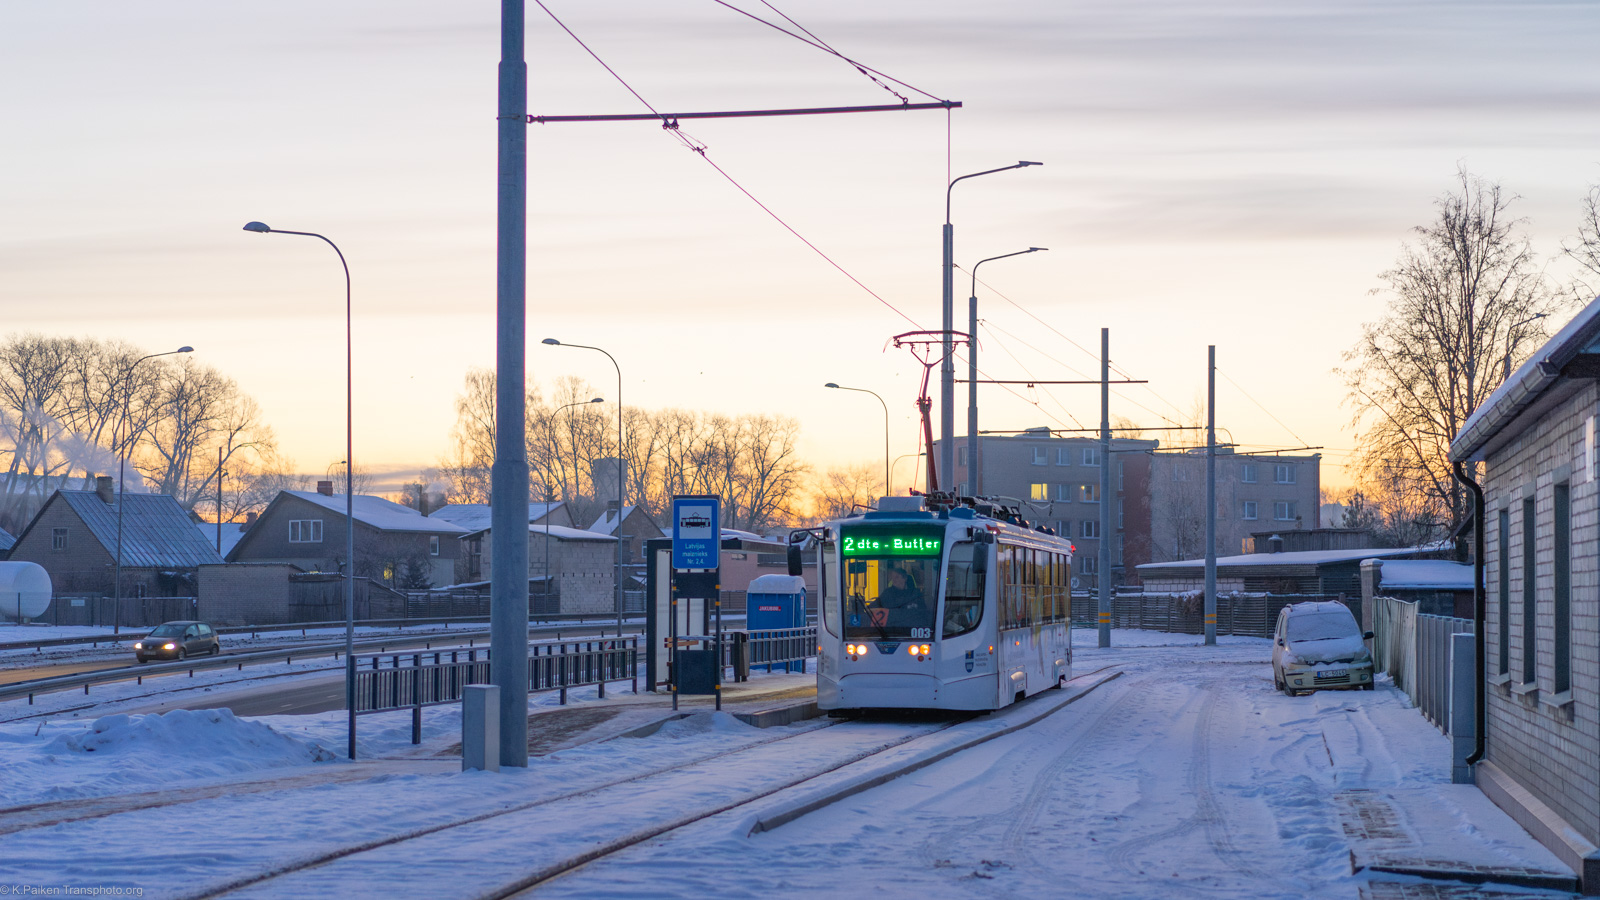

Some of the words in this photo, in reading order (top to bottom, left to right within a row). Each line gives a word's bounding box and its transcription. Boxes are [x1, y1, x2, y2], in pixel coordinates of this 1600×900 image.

[844, 537, 855, 551] 2
[857, 539, 879, 549] dte
[911, 628, 931, 638] 003
